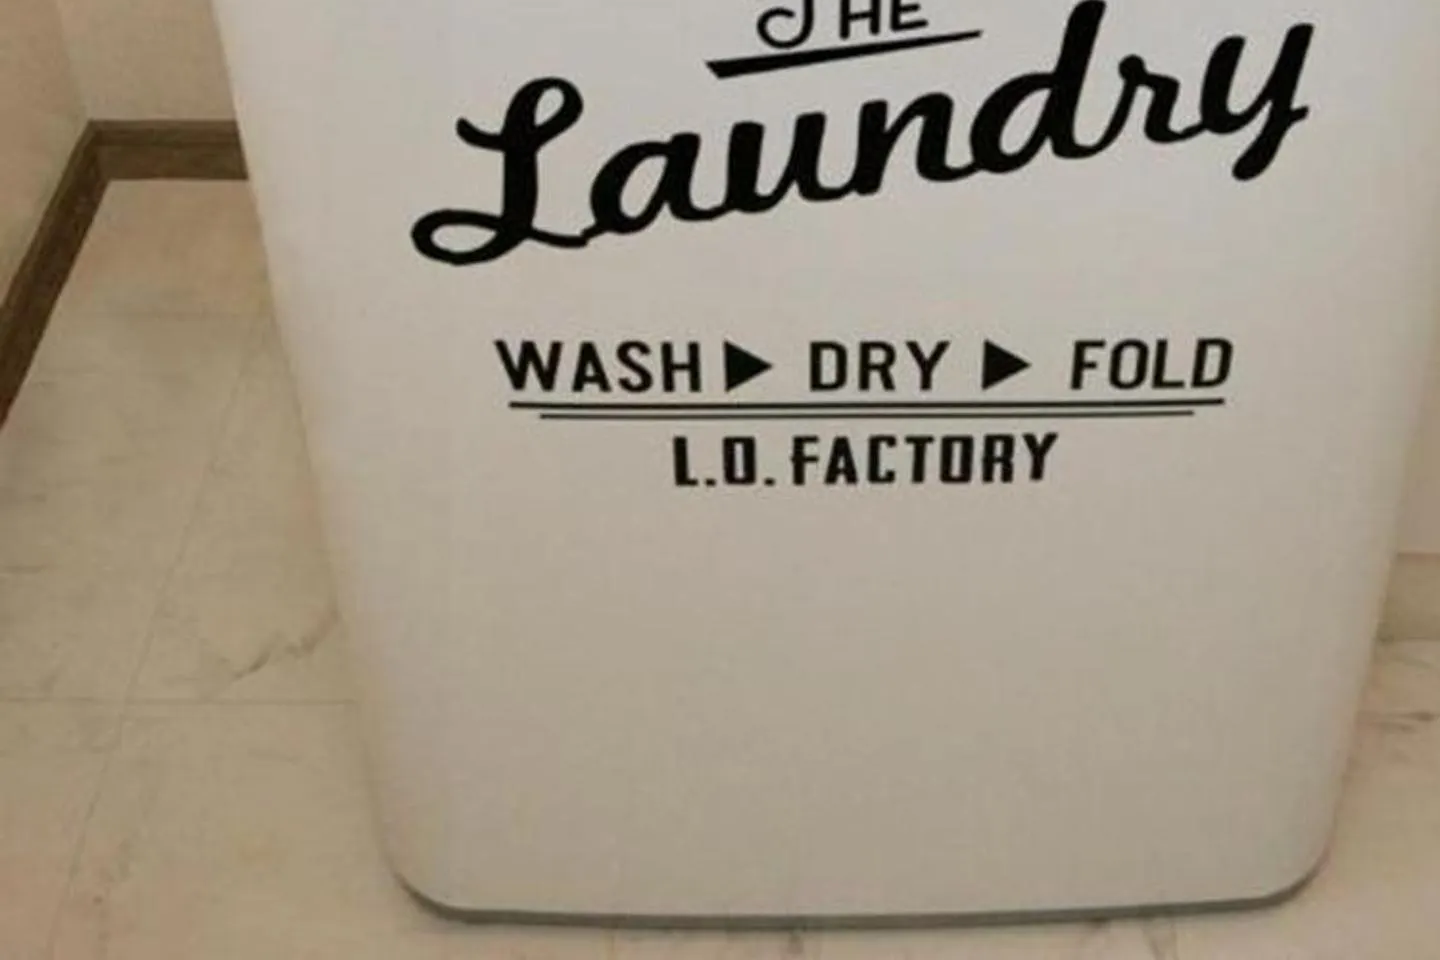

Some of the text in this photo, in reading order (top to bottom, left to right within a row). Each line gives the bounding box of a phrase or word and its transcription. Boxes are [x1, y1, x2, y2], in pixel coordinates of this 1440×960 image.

[494, 338, 1233, 393] WASH DRY FOLD
[790, 432, 1058, 486] FACTORY
